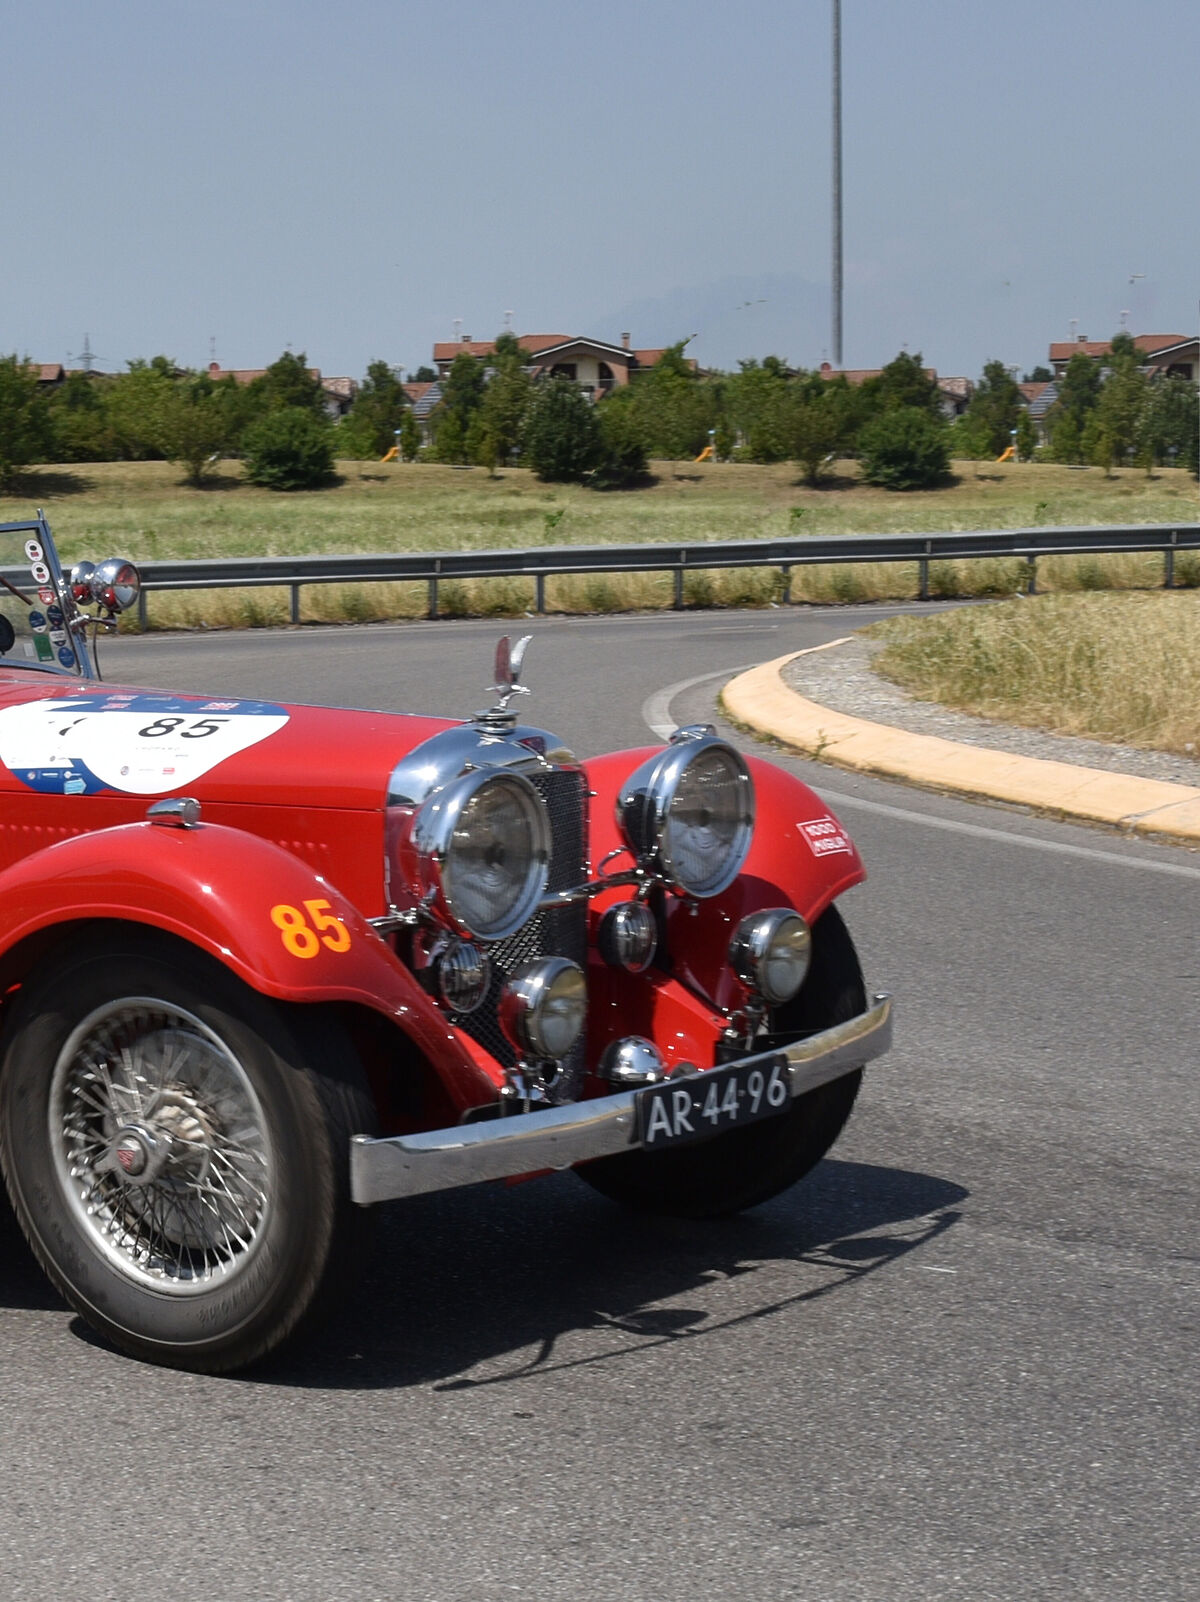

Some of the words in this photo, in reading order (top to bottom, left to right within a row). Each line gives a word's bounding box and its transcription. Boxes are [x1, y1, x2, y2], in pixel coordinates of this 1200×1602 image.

[138, 717, 232, 739] 85
[805, 822, 837, 837] 1000
[270, 899, 351, 959] 85
[646, 1066, 787, 1143] AR-44-96
